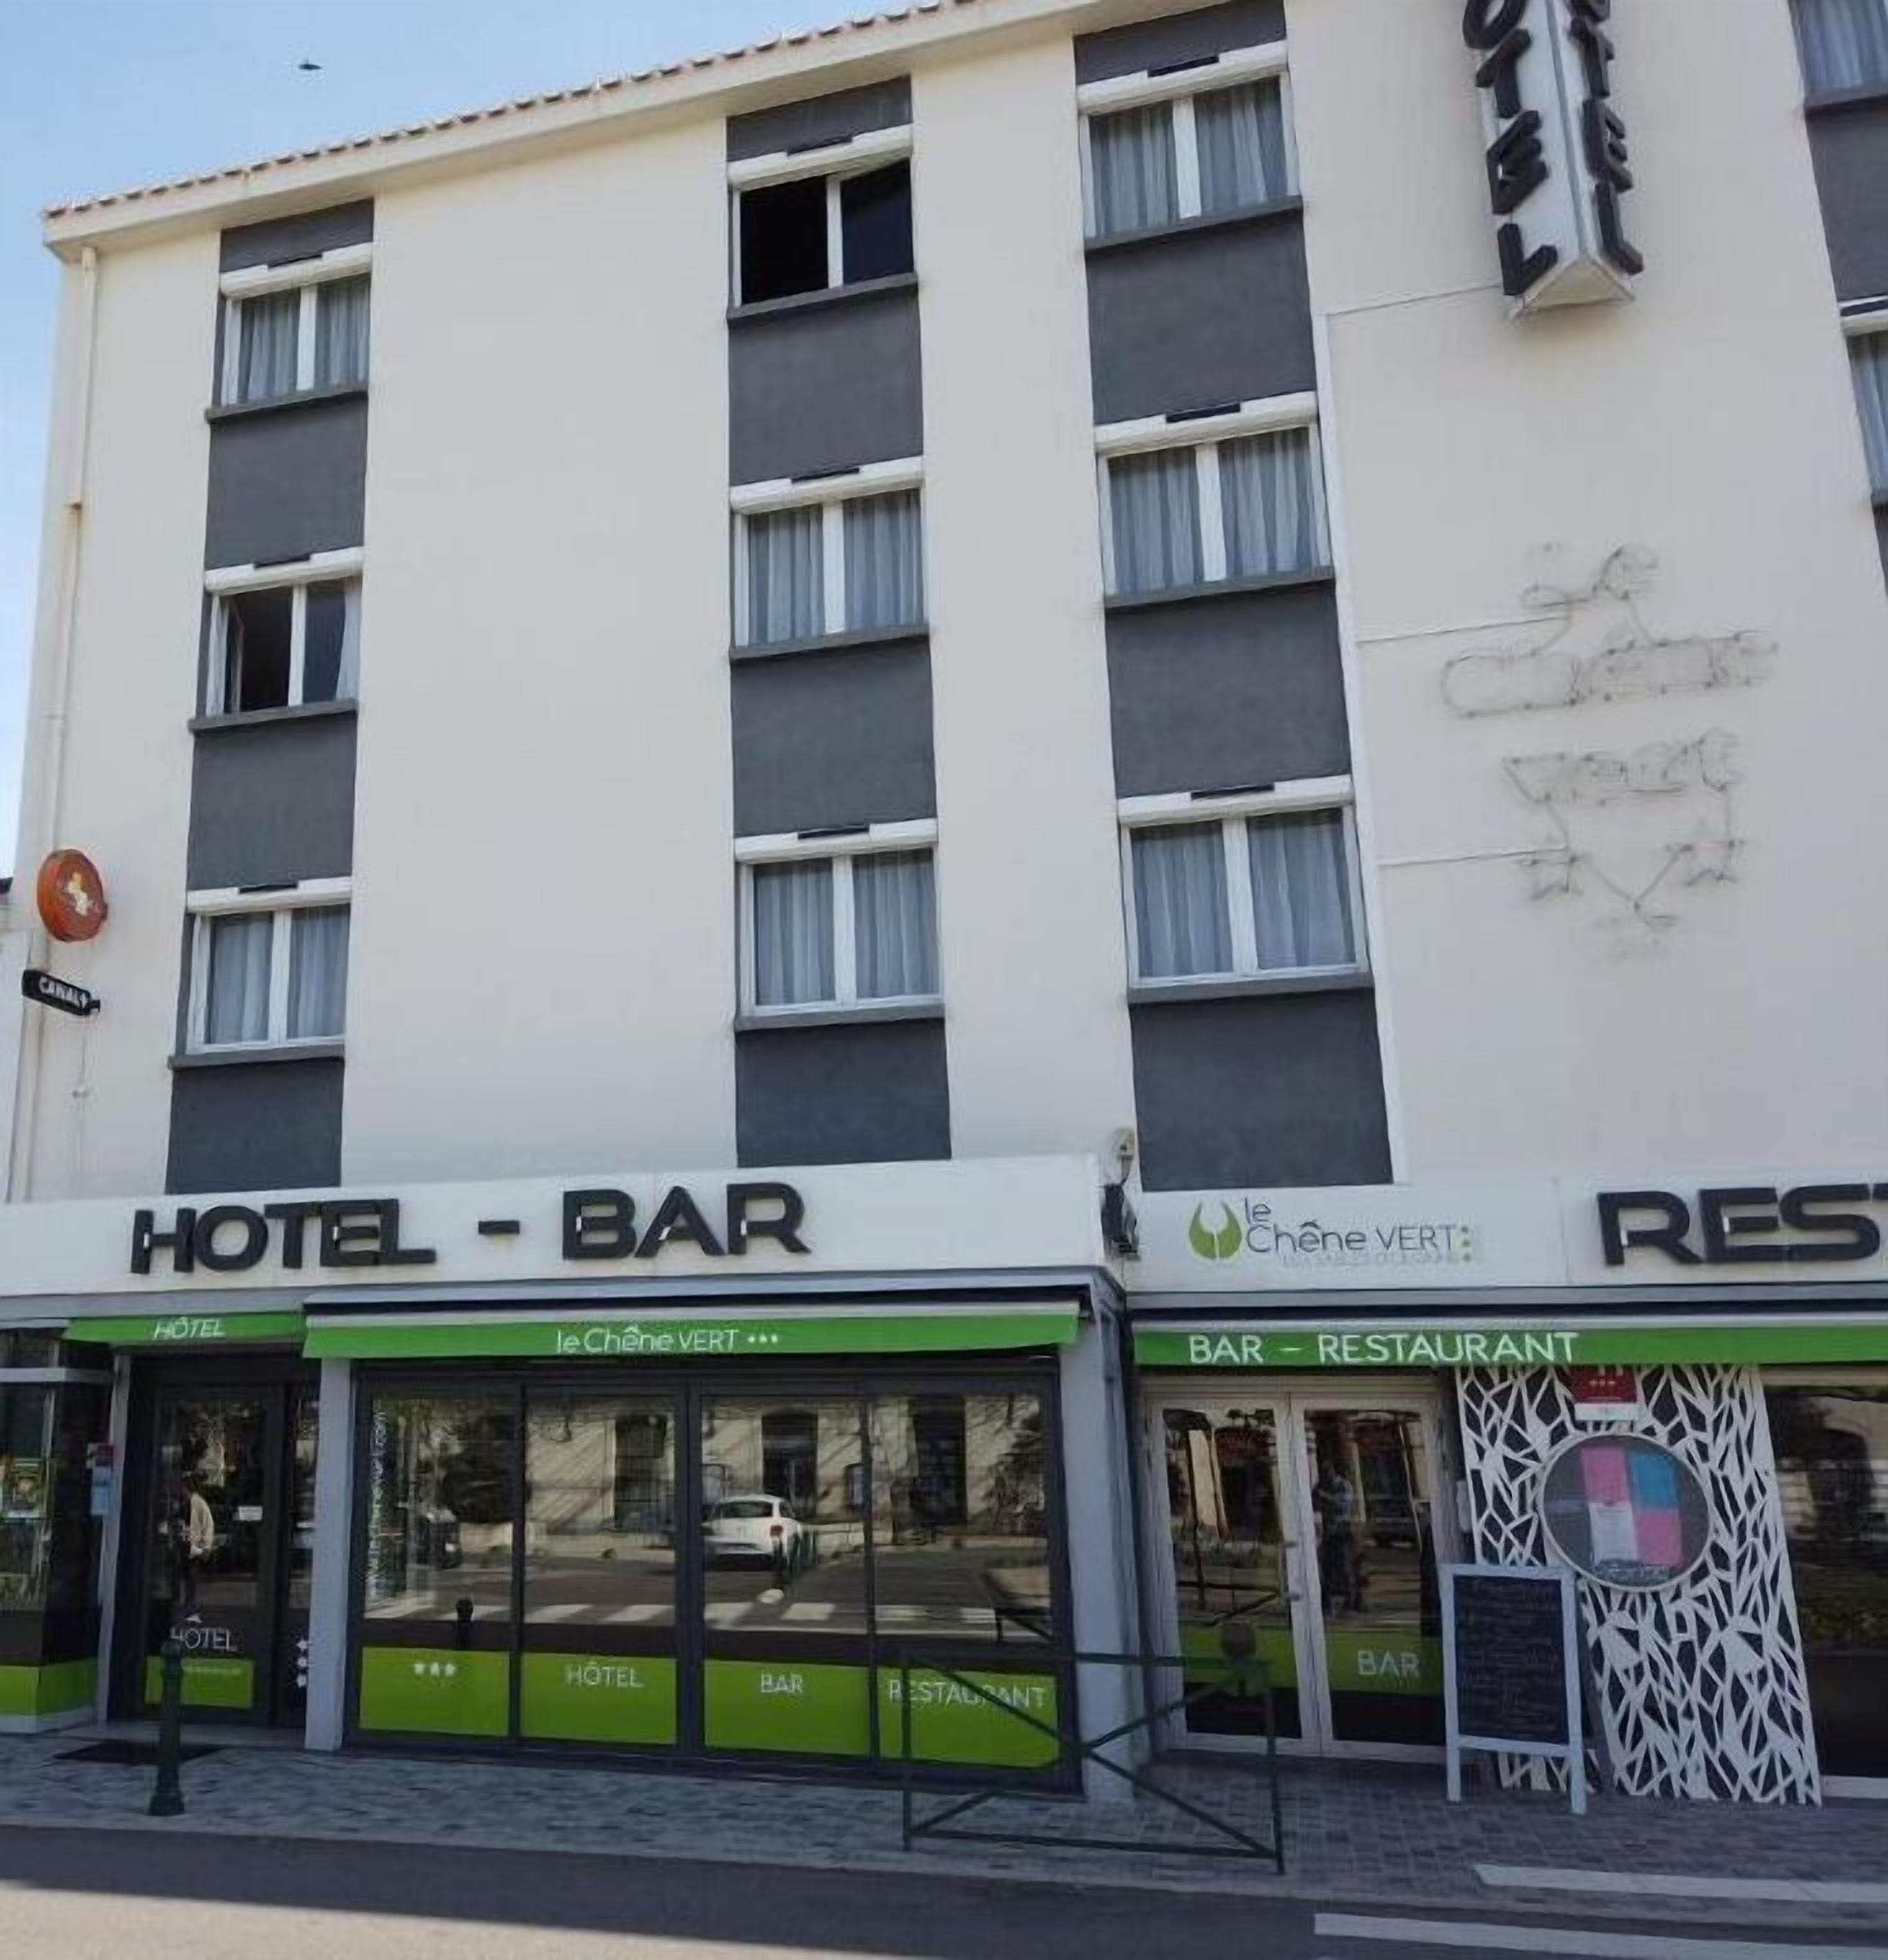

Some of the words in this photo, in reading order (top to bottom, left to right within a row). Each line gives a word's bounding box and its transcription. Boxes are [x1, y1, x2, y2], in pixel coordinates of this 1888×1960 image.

[1244, 1197, 1271, 1223] le
[1596, 1183, 1888, 1266] RES
[130, 1198, 436, 1275] HOTEL
[562, 1181, 812, 1261] BAR
[1246, 1220, 1366, 1253] Chêne
[1375, 1224, 1457, 1252] VERT
[153, 1316, 226, 1340] HÔTEL
[678, 1329, 740, 1352] VERT
[1188, 1334, 1264, 1364] BAR
[1317, 1332, 1579, 1364] RESTAURANT
[169, 1613, 239, 1652] HÔTEL
[566, 1660, 646, 1689] HÔTEL
[1357, 1649, 1421, 1678] BAR
[760, 1673, 803, 1694] BAR
